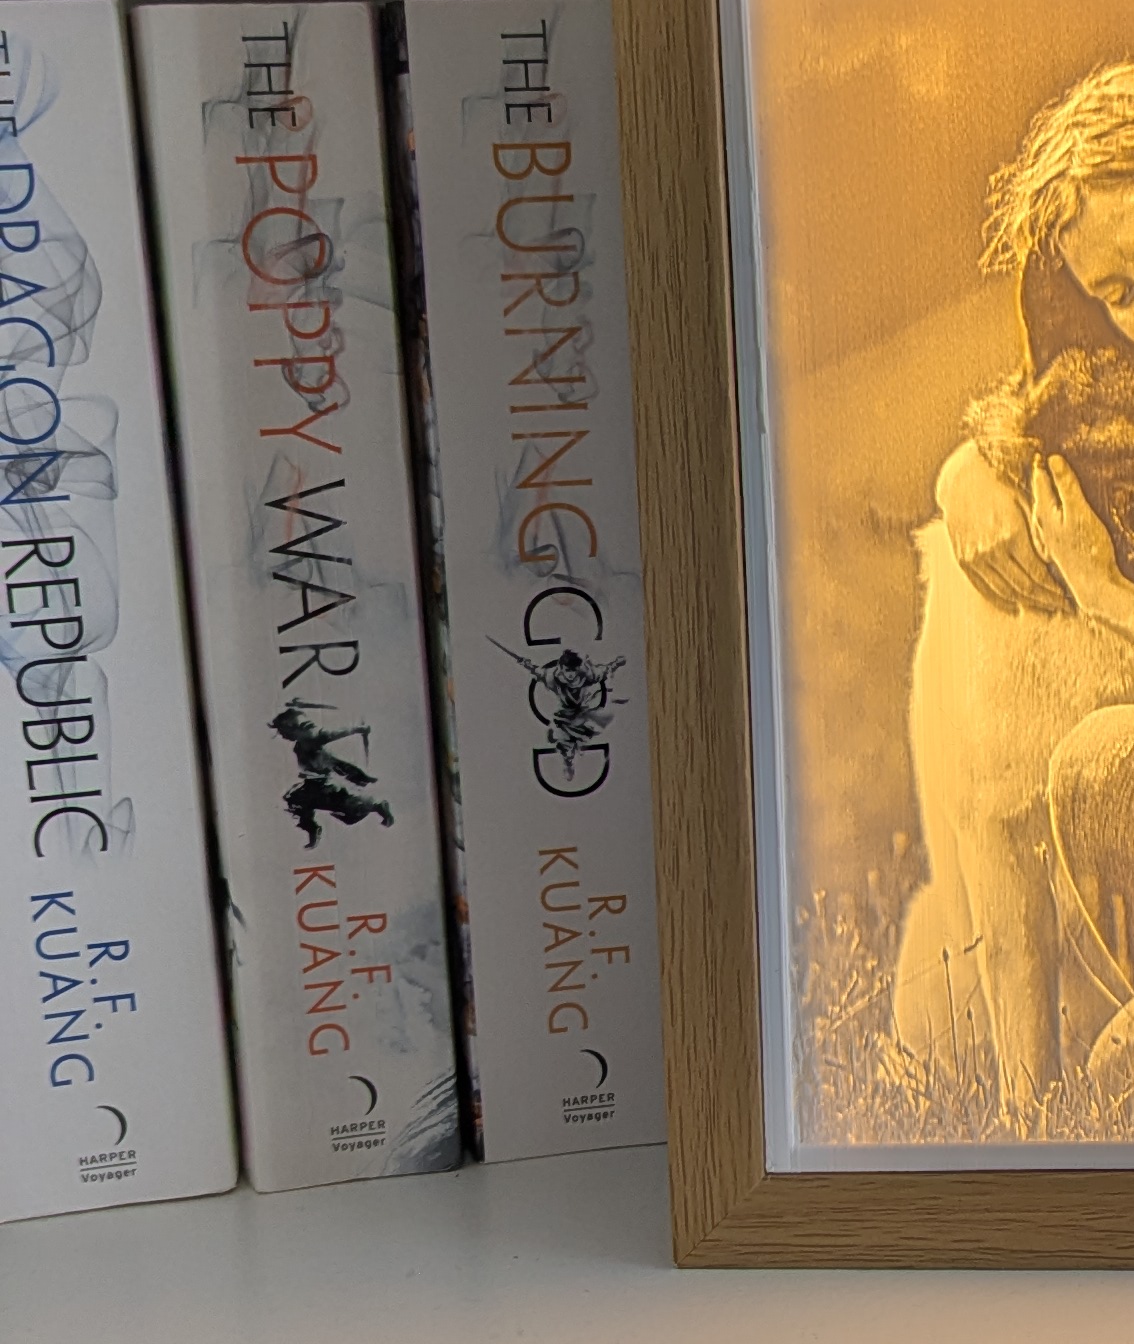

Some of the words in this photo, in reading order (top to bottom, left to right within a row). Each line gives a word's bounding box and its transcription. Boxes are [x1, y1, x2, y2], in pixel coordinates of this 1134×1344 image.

[241, 20, 298, 130] THE
[500, 18, 553, 126] THE
[235, 153, 343, 455] POPPY
[491, 140, 598, 563] BURNING
[263, 477, 361, 689] WAR
[1, 534, 108, 858] REPUBLIC
[523, 586, 610, 798] GOD
[30, 890, 96, 1088] KUANG
[86, 939, 138, 1030] R.F.
[292, 863, 352, 1057] KUANG
[346, 911, 393, 1000] R.F.
[537, 845, 590, 1035] KUANG
[586, 893, 632, 982] R.F.
[329, 1119, 387, 1137] HARPER
[331, 1137, 387, 1154] Voyager
[562, 1091, 616, 1109] HARPER
[563, 1109, 616, 1126] Voyager
[78, 1149, 138, 1167] HARPER
[79, 1167, 138, 1185] Voyager
